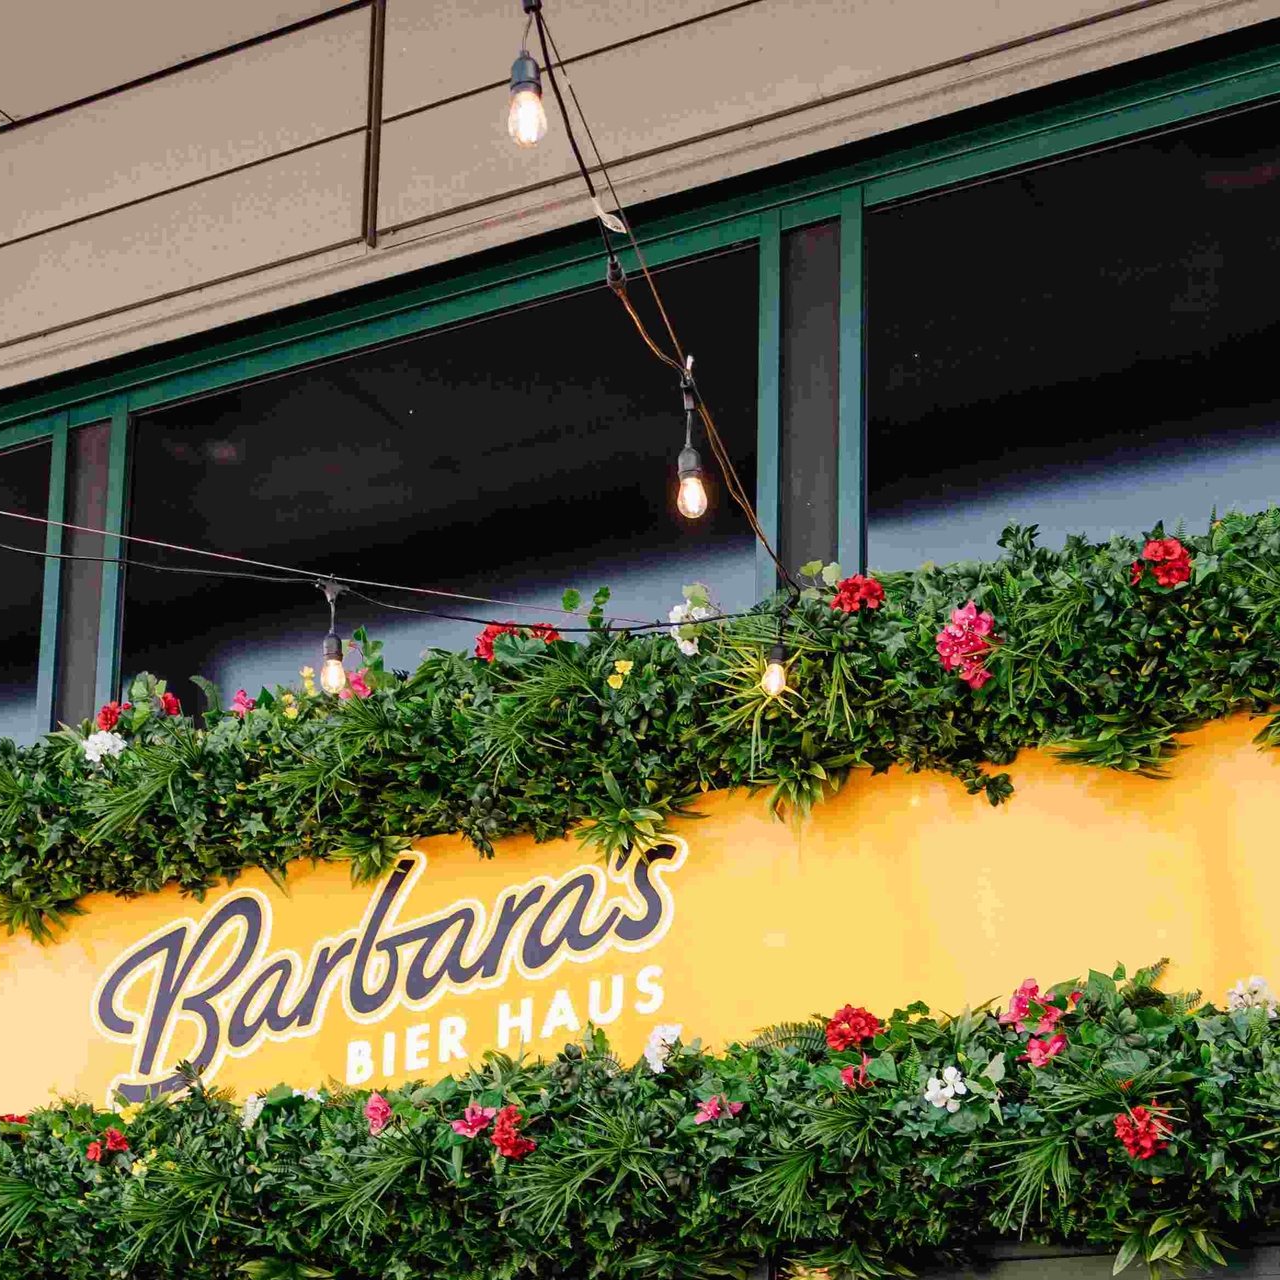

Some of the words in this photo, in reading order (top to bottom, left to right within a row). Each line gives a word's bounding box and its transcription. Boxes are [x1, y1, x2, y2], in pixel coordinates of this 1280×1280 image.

[94, 837, 680, 1105] Barbara's
[346, 1016, 468, 1086] BIER
[497, 965, 664, 1049] HAUS
